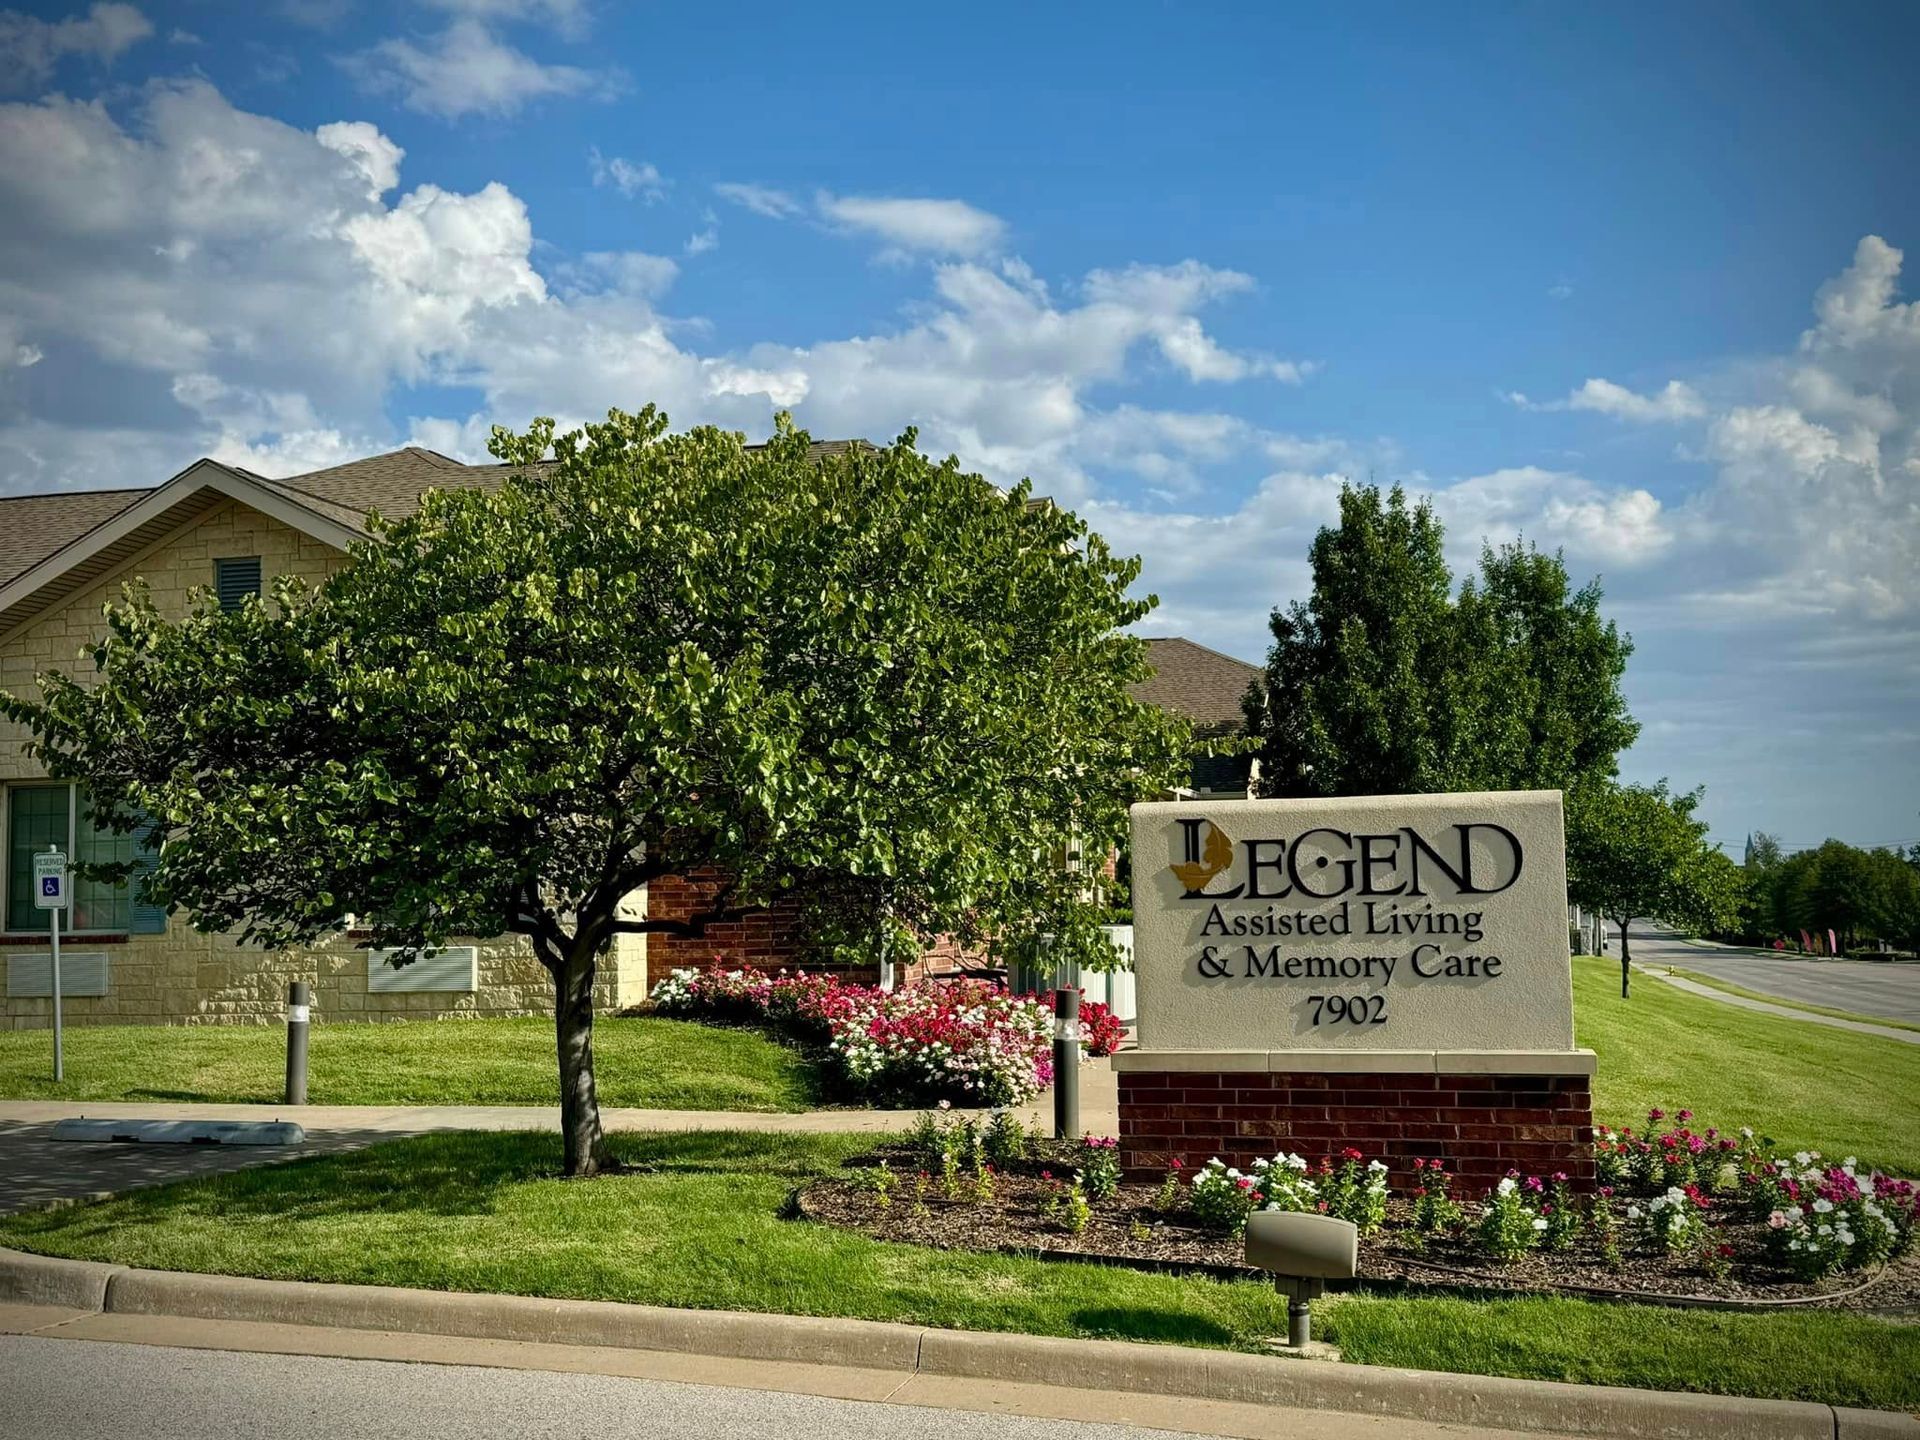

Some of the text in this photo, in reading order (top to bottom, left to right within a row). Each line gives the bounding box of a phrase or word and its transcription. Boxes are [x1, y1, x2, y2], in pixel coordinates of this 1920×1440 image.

[36, 857, 63, 866] RESERVED
[38, 867, 62, 876] PARKING
[1174, 818, 1523, 900] LEGEND
[1200, 901, 1484, 941] Assisted Living
[1198, 943, 1503, 986] & Memory Care
[1306, 995, 1388, 1026] 7902
